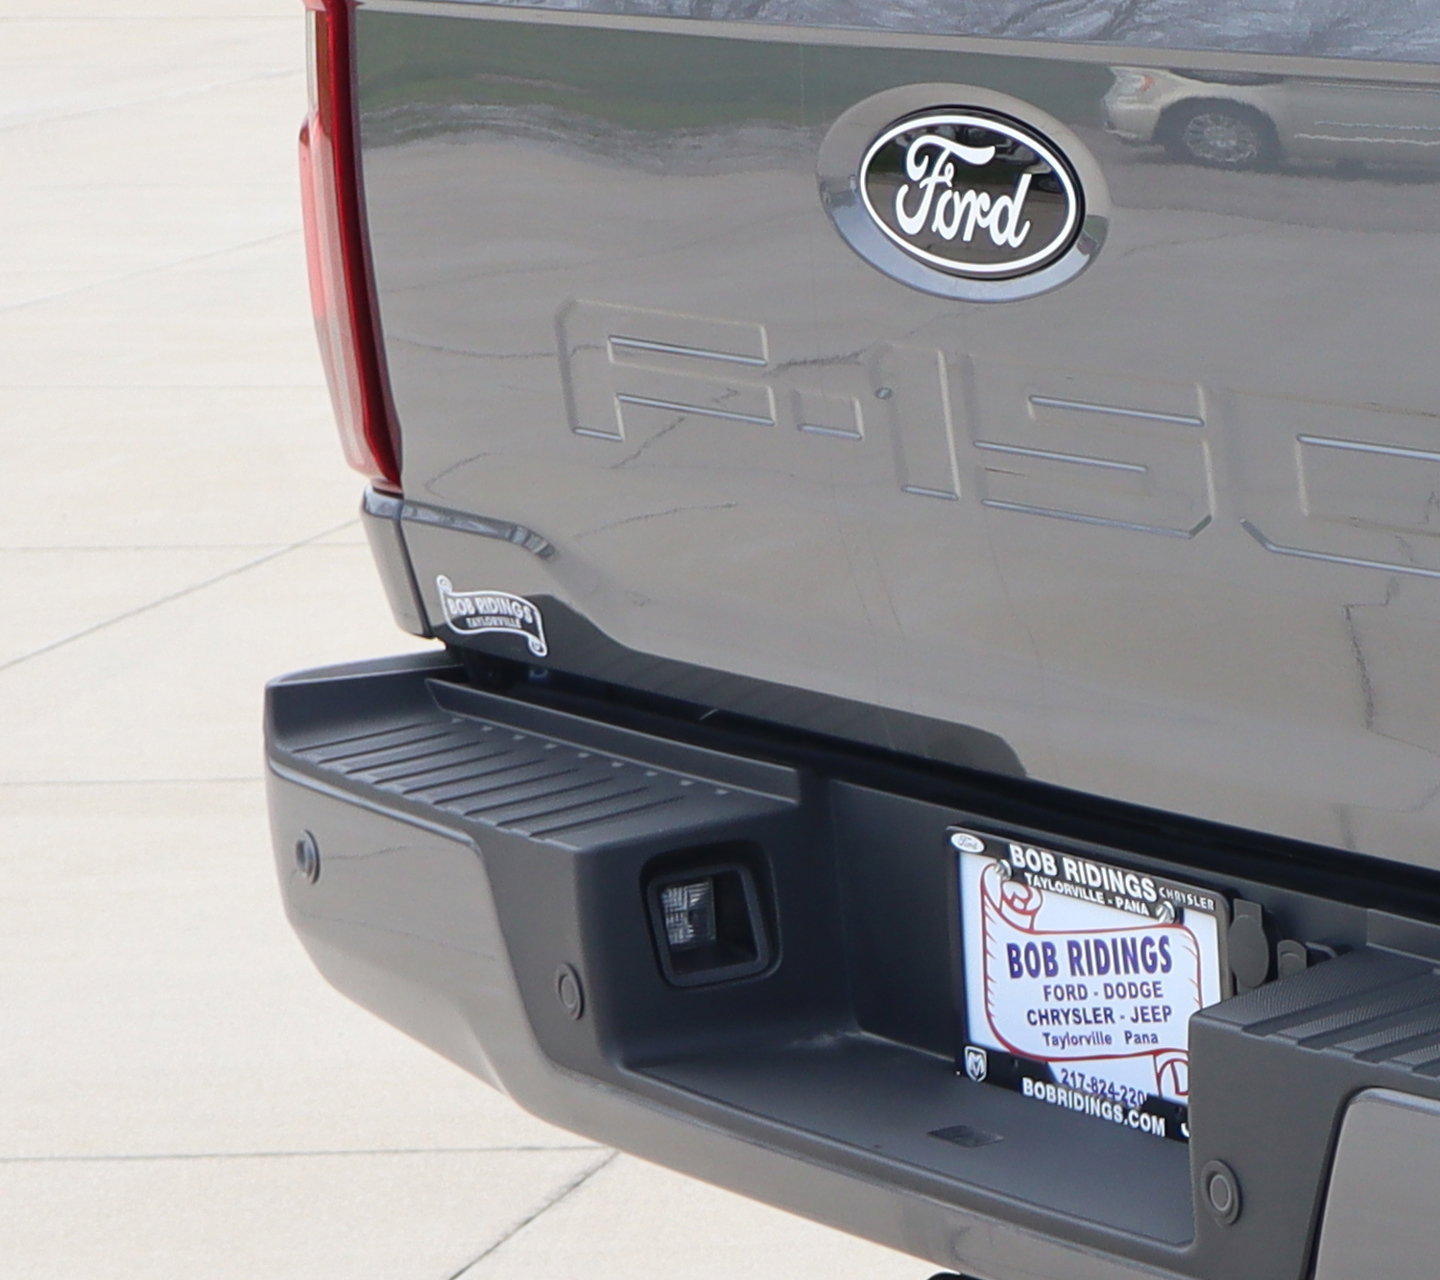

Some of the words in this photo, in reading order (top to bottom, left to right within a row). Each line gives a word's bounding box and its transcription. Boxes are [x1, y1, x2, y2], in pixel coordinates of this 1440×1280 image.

[896, 134, 1032, 248] Ford
[447, 597, 475, 615] BOB
[475, 597, 533, 624] RIDINGS
[1009, 844, 1058, 877] BOB
[1062, 857, 1157, 902] RIDINGS
[1024, 872, 1105, 905] TAYLORVILLE
[1115, 895, 1150, 916] PANA
[1159, 886, 1215, 912] CHRYSLER
[1006, 941, 1059, 979] BOB
[1067, 935, 1173, 977] RIDINGS
[1043, 983, 1088, 1002] FORD
[1103, 981, 1164, 1000] DODGE
[1027, 1007, 1116, 1026] CHRYSLER
[1130, 1005, 1173, 1023] JEEP
[1042, 1031, 1112, 1050] Taylorville
[1124, 1030, 1159, 1045] Pana
[1022, 1077, 1166, 1137] BOBRIDINGS.COM
[1060, 1068, 1147, 1108] 217-824-220
